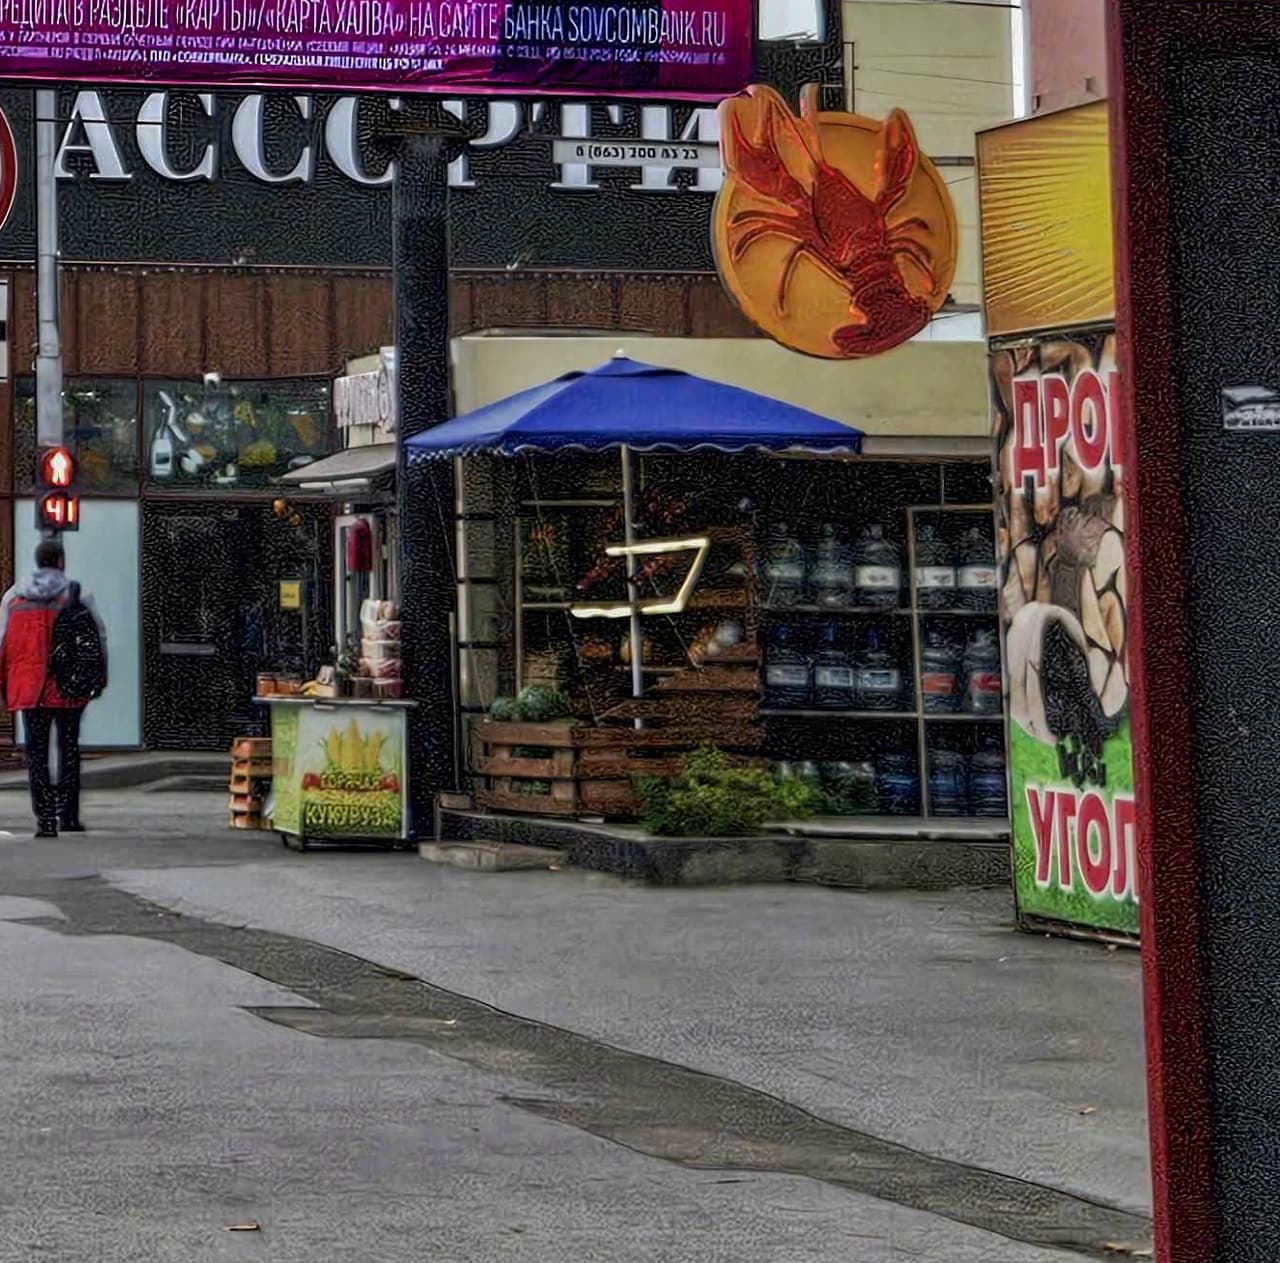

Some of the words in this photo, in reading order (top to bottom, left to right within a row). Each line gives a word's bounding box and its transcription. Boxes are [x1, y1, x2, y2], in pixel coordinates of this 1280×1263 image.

[409, 2, 434, 37] НА
[440, 0, 497, 39] САЙТЕ
[504, 3, 564, 40] БАНКА
[568, 4, 726, 47] SOVCOMBANK.RU
[46, 499, 76, 523] 41
